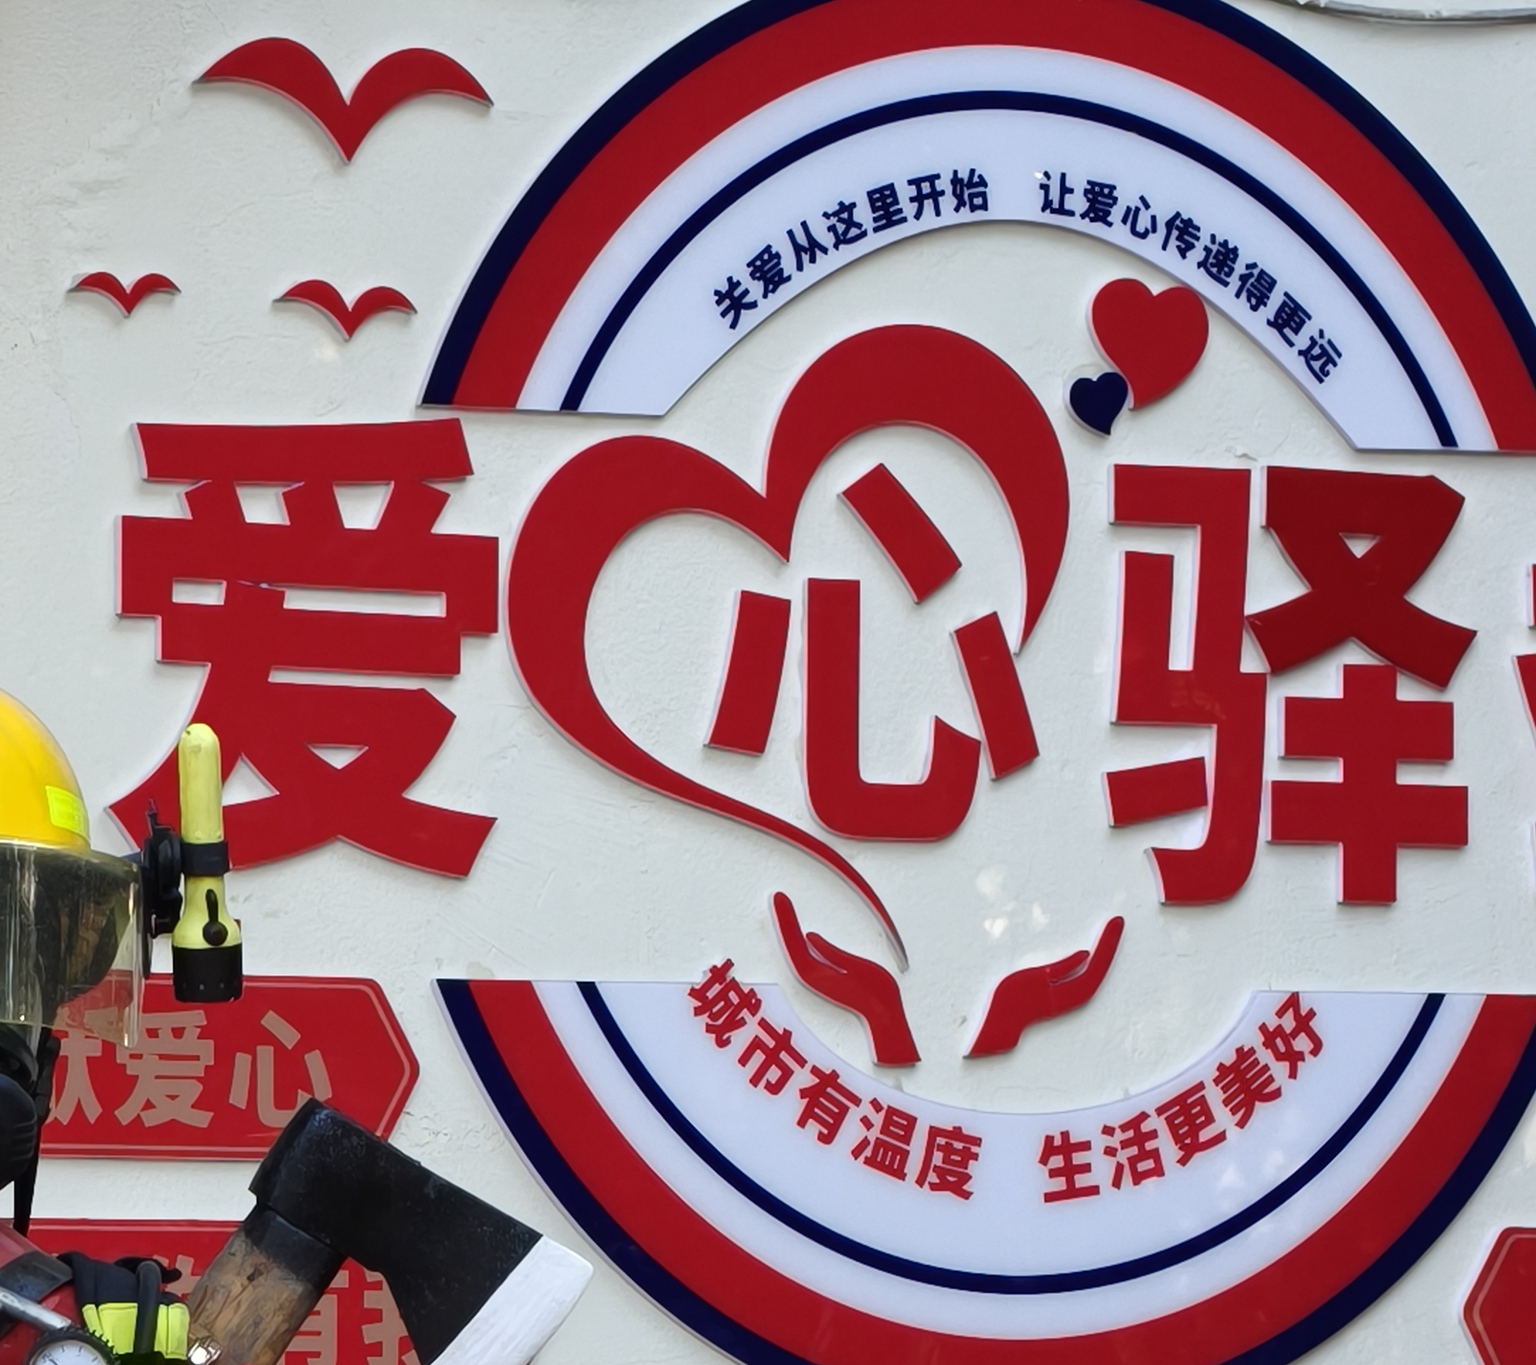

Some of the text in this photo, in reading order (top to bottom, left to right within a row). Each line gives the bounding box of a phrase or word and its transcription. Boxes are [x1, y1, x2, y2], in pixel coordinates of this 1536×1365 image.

[713, 168, 1343, 384] 关爱从这里开始 让爱心传递得更远
[105, 417, 1536, 906] 爱心驿
[687, 958, 1327, 1203] 城市有温度 生活更美好
